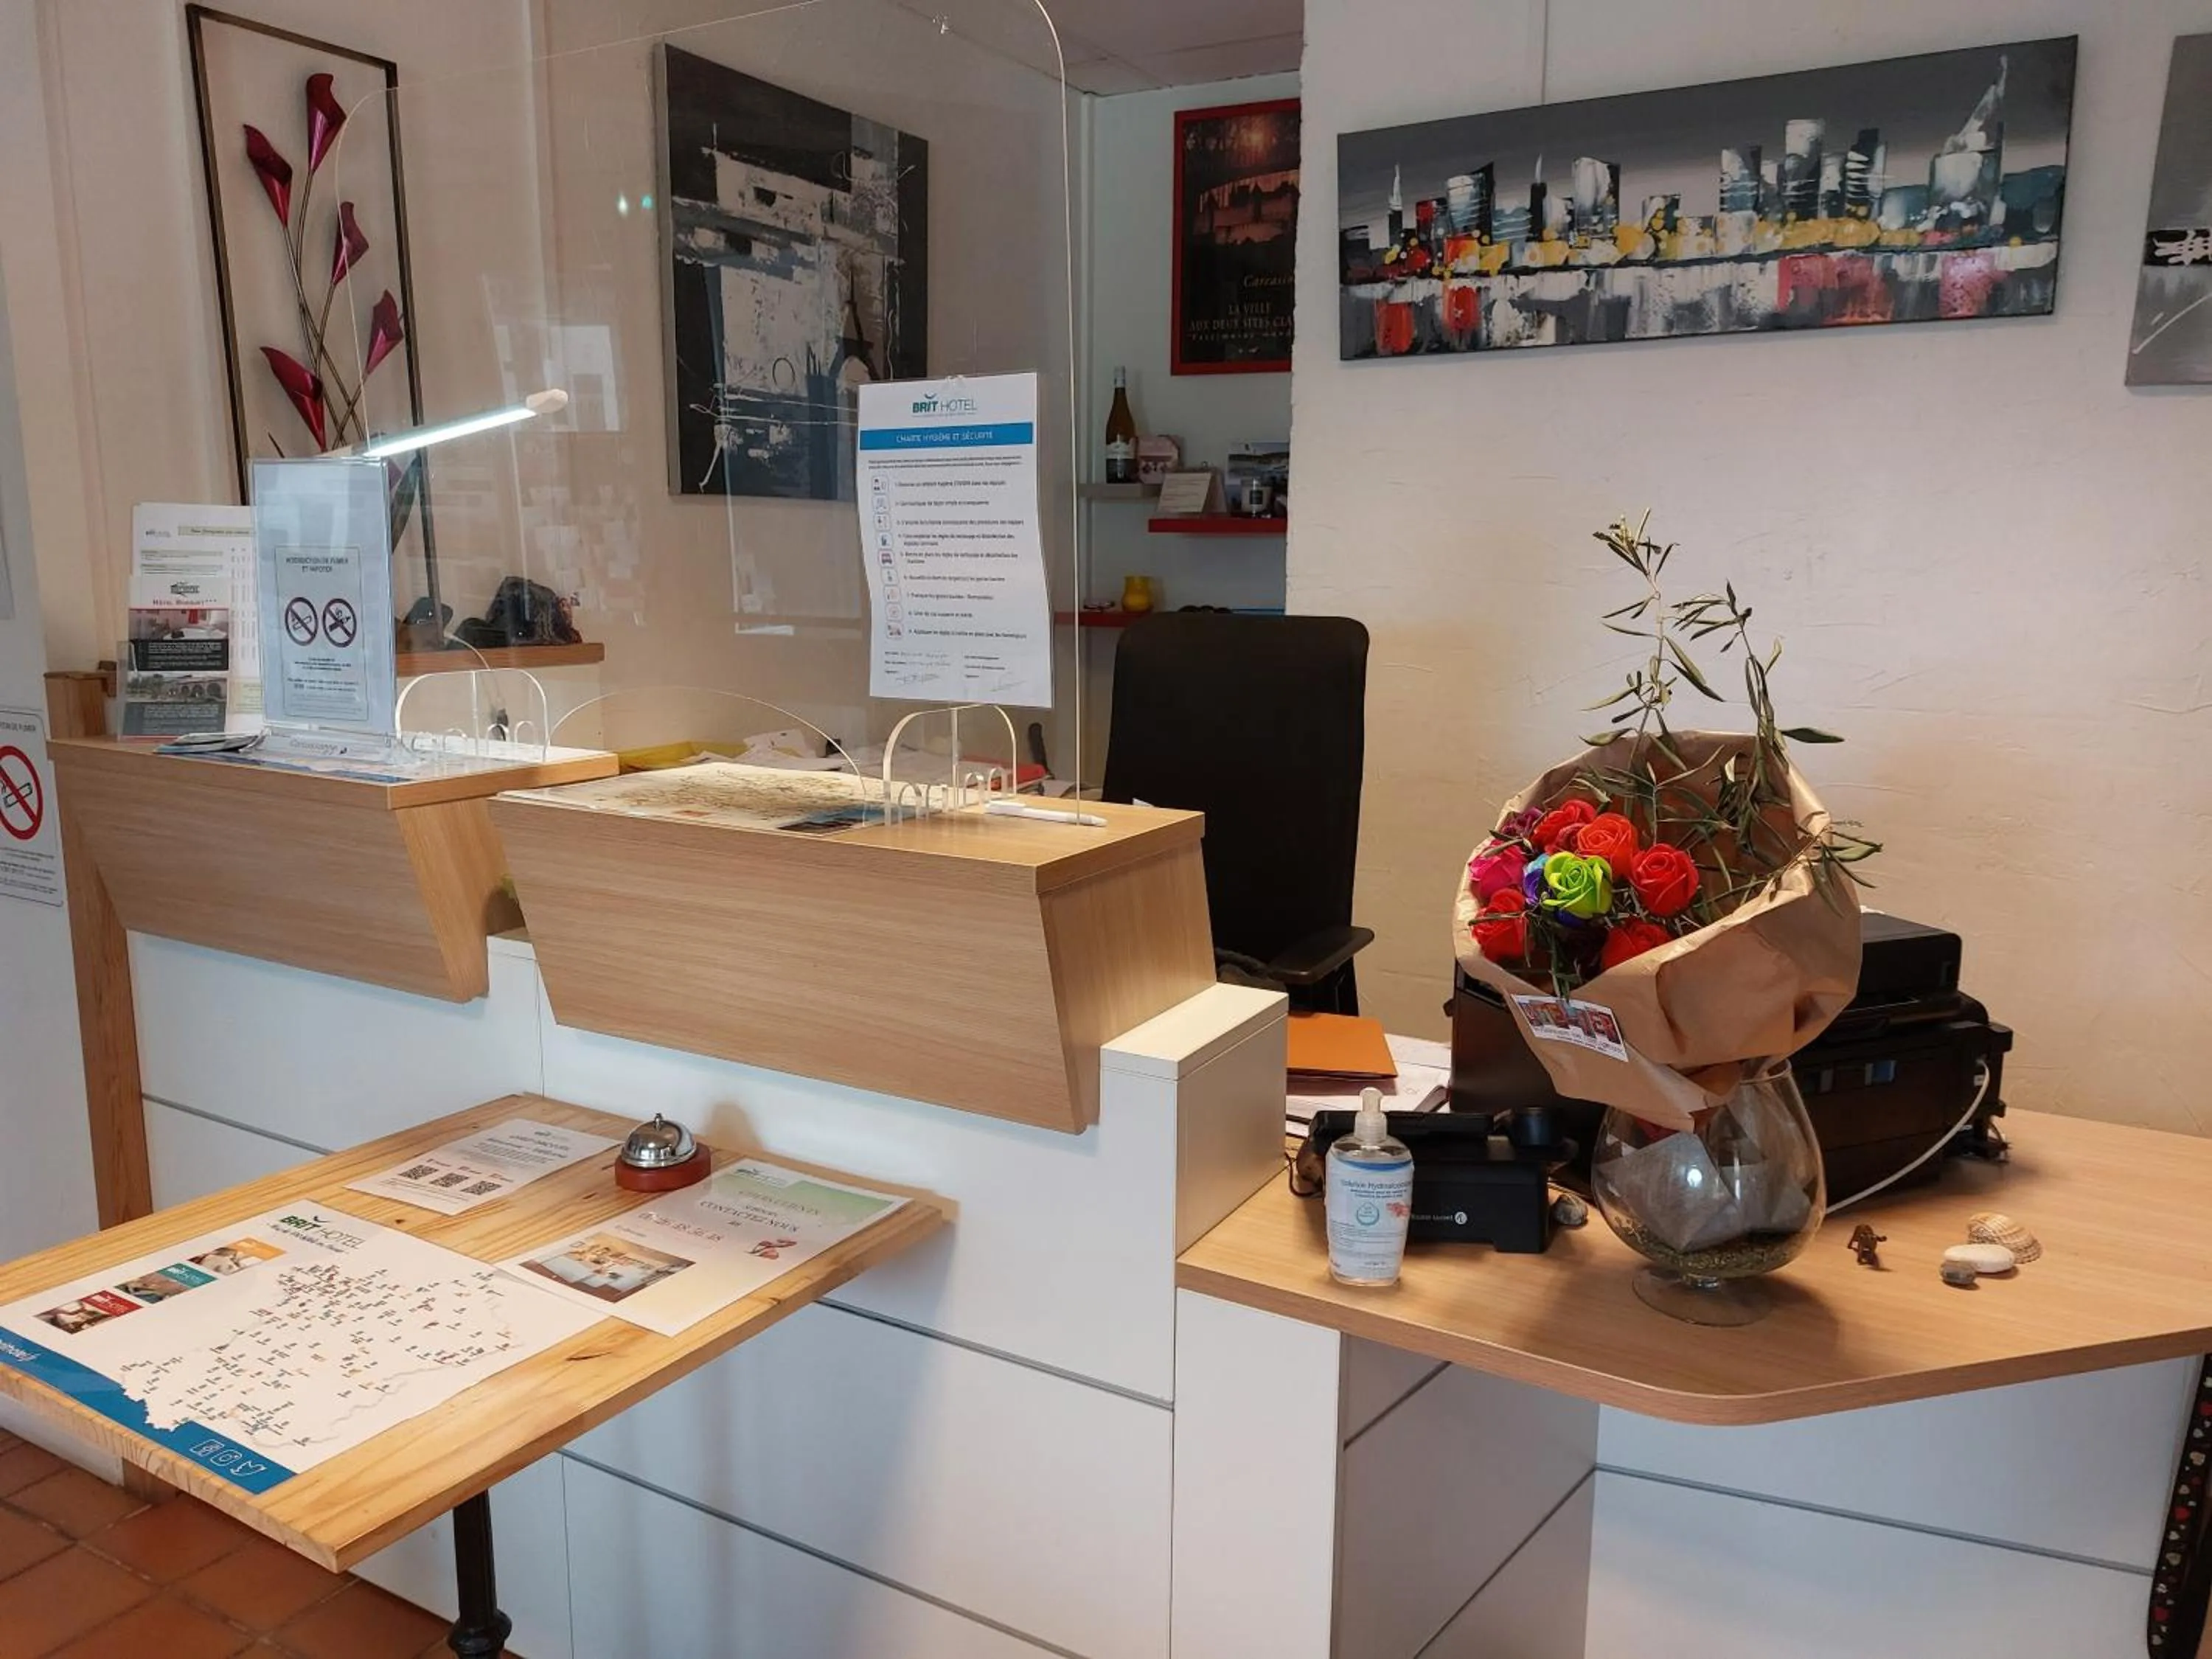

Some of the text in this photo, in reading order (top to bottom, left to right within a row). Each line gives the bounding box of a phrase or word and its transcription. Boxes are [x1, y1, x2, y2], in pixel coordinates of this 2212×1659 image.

[912, 399, 977, 413] BRIT HOTEL
[279, 1216, 321, 1231] BRIT
[319, 1228, 366, 1250] HOTEL
